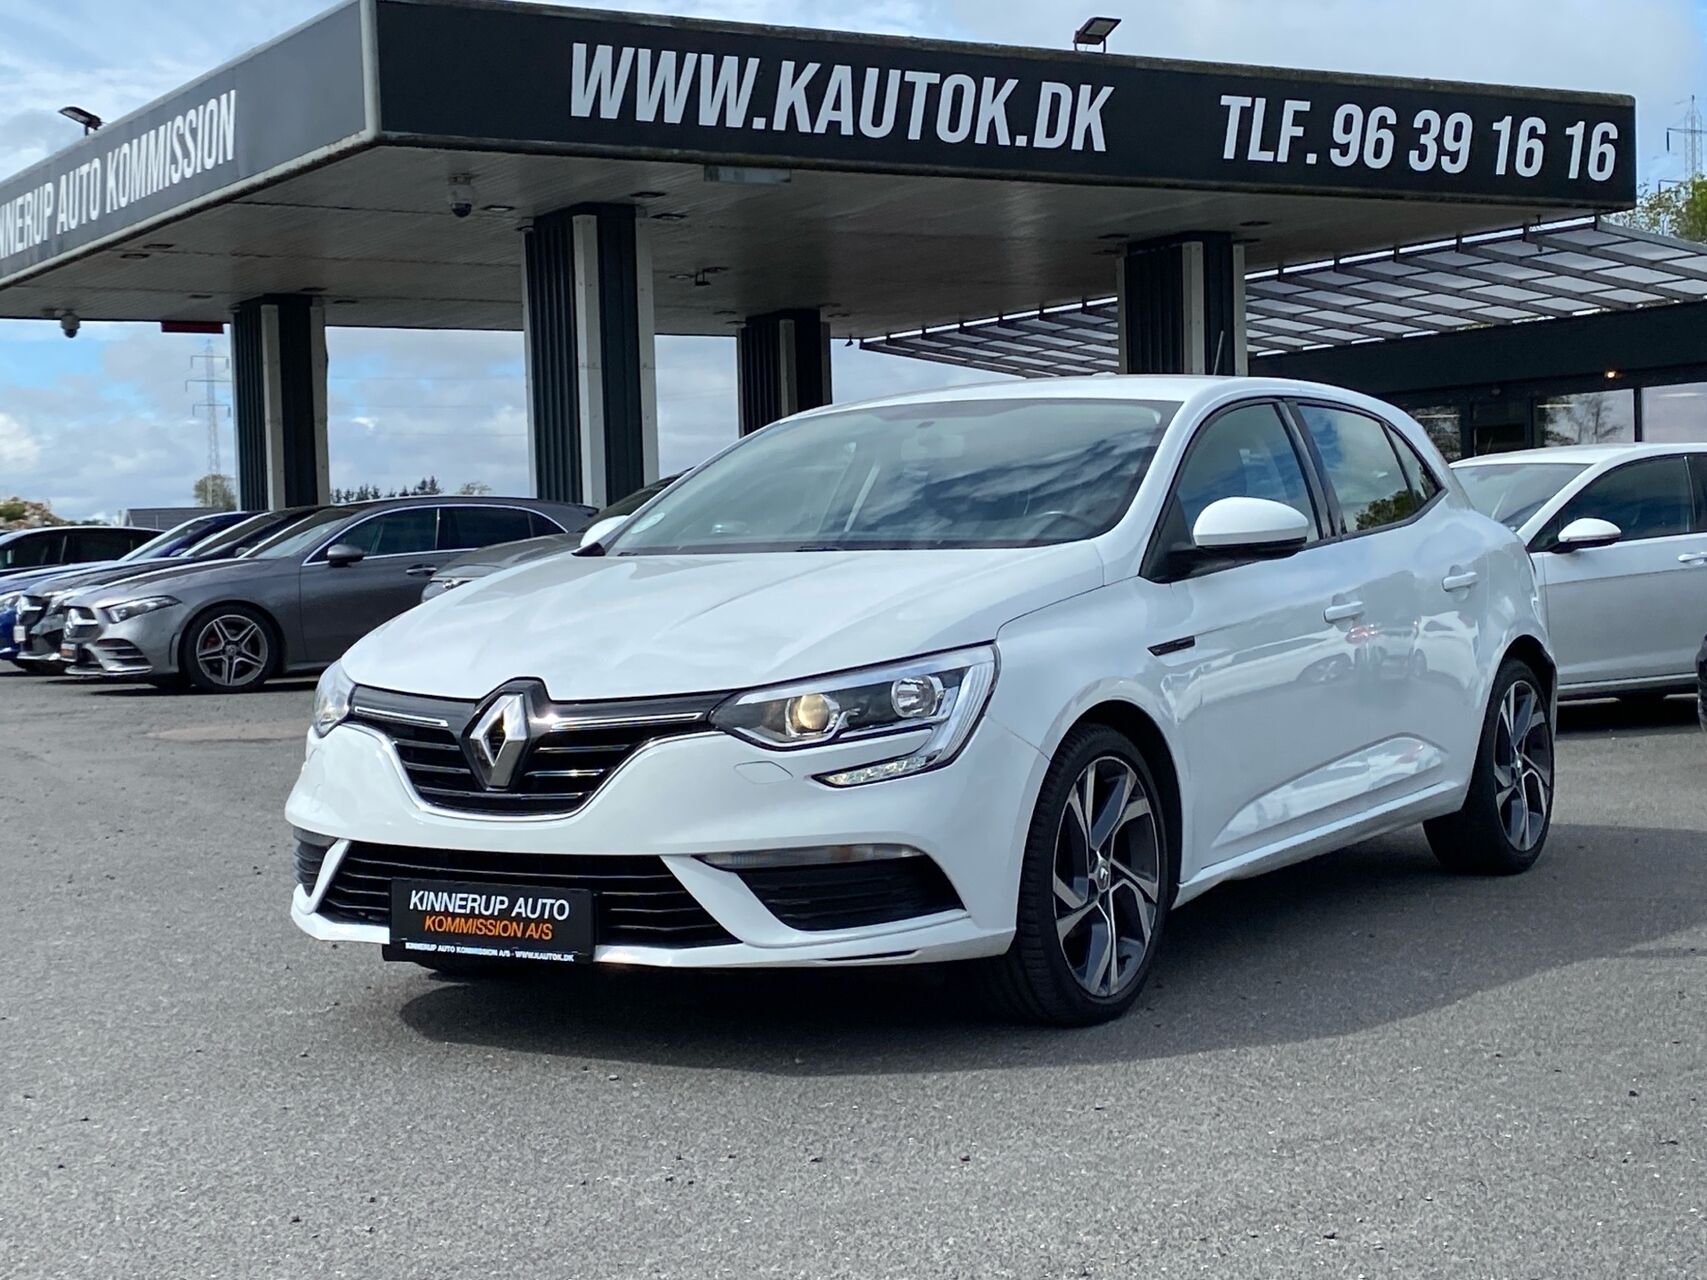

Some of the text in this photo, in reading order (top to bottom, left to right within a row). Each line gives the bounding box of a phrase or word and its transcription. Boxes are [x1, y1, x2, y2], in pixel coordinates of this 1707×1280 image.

[570, 42, 1619, 182] WWW.KAUTOK.DK TLF. 96 39 16 16
[56, 157, 101, 235] AUTO
[106, 89, 236, 214] KOMMISSION
[410, 890, 569, 920] KINNERUP AUTO
[425, 915, 552, 940] KOMMISSION A/S
[437, 944, 456, 953] AUTO
